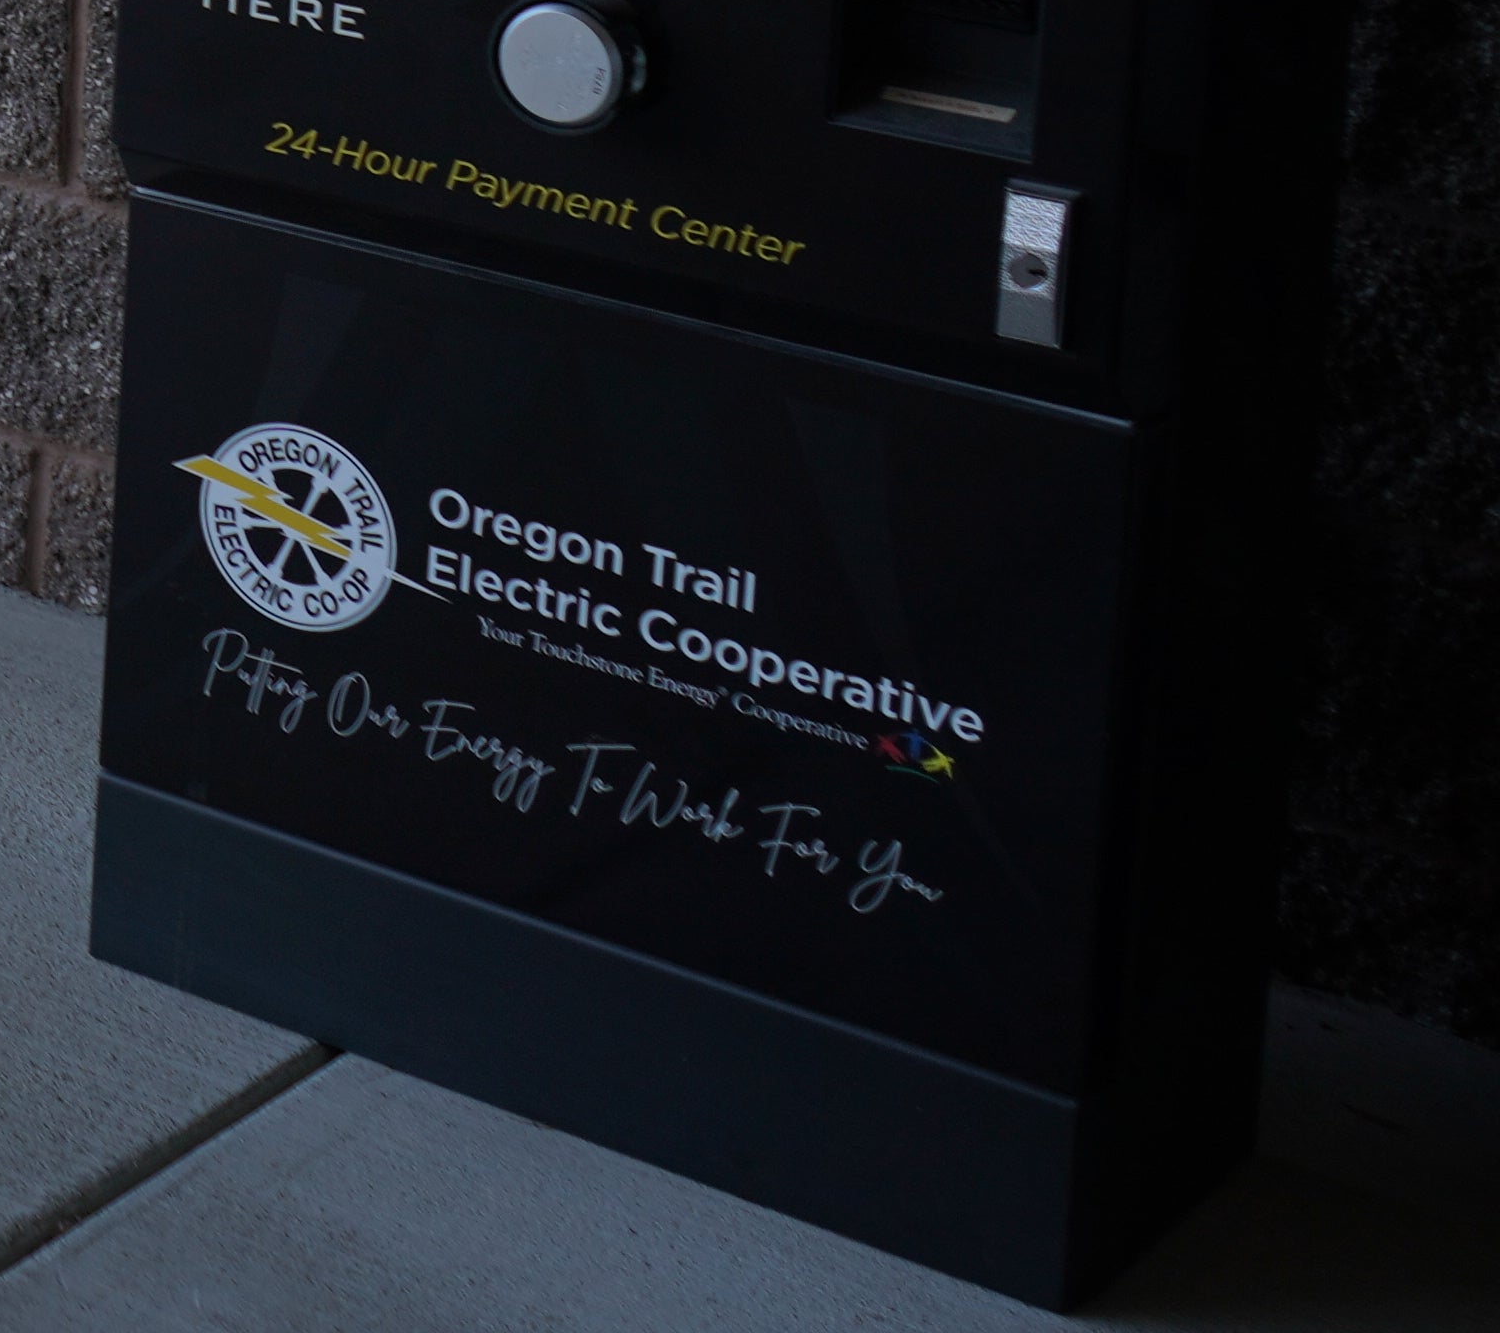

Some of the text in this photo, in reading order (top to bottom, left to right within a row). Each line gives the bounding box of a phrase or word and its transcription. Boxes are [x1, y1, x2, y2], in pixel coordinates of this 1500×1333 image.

[263, 121, 807, 267] 24-Hour Payment Center
[214, 504, 371, 617] ELECTRIC CO-OP
[238, 438, 384, 553] OREGON TRAIL
[428, 487, 756, 614] Oregon Trail
[425, 544, 985, 744] Electric Cooperative
[477, 614, 527, 649] Your
[527, 629, 646, 683] Touchstone
[731, 691, 871, 751] Cooperative
[202, 628, 946, 915] Putting Our Energy To Work For You
